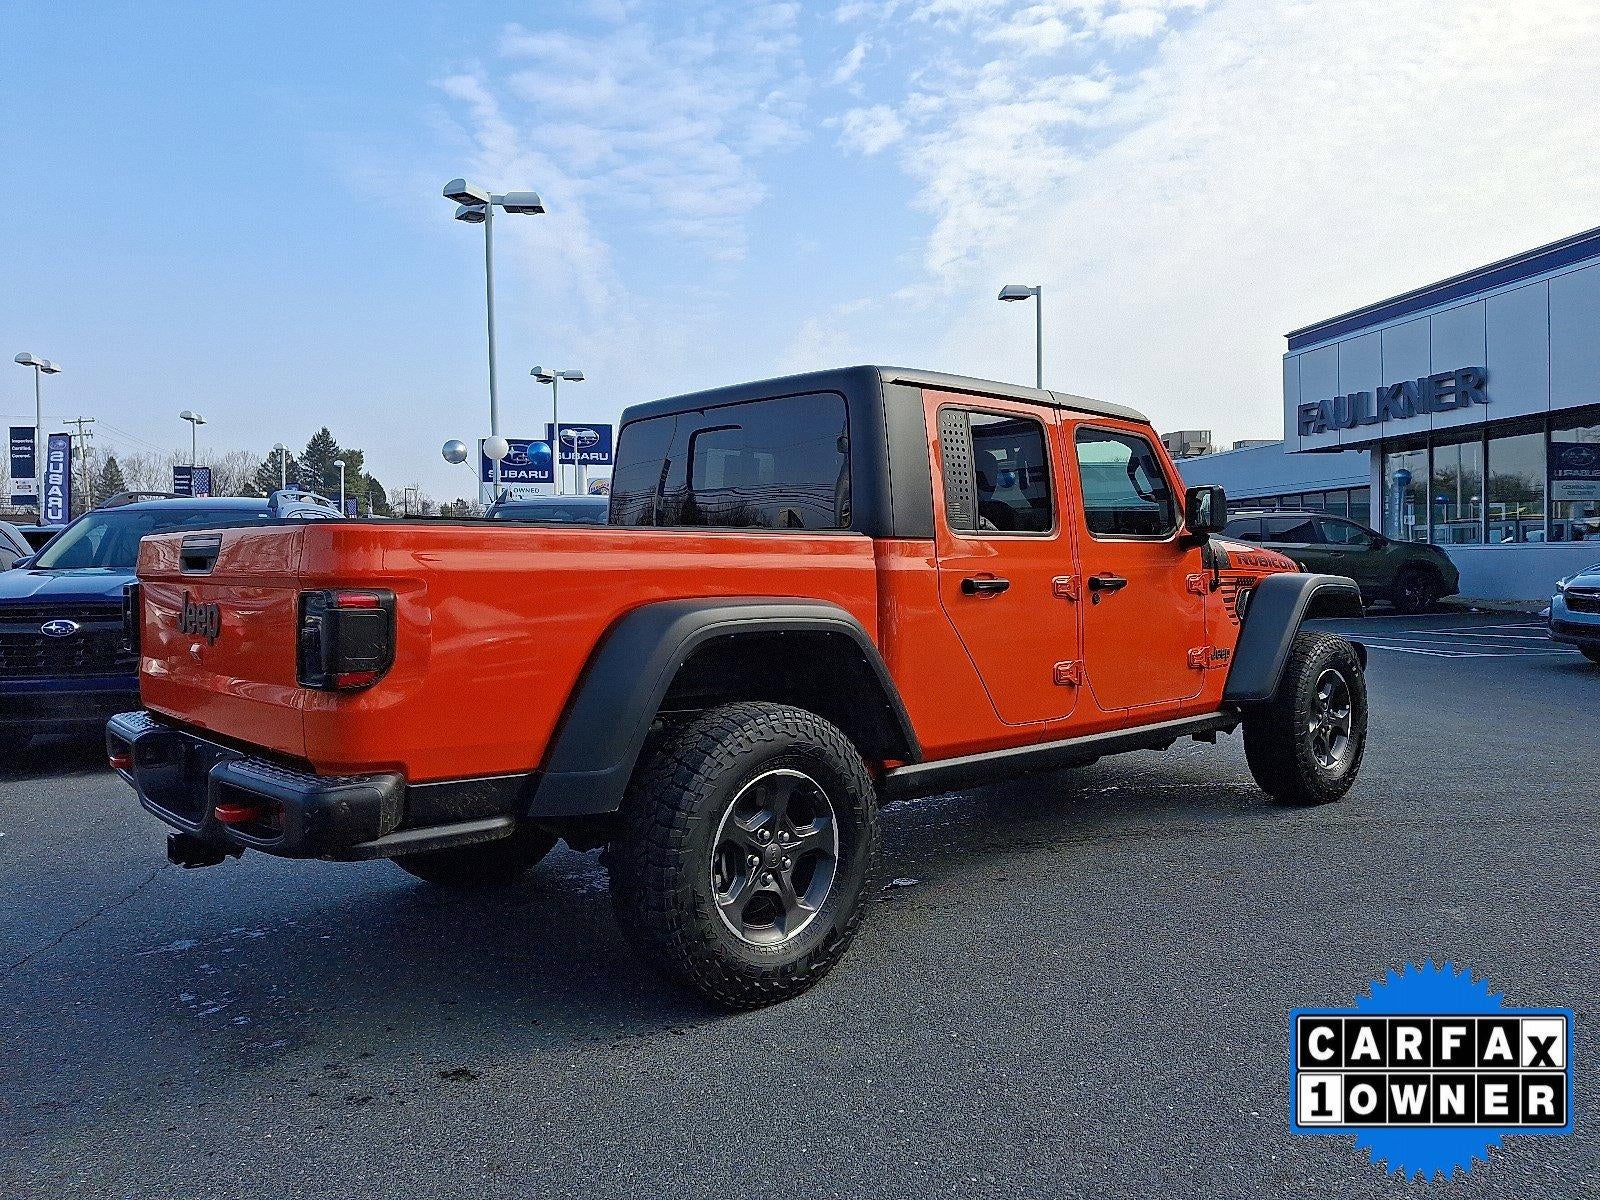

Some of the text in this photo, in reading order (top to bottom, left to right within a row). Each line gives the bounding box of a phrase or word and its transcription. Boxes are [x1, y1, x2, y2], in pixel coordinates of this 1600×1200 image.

[1298, 366, 1489, 436] FAULKNER
[47, 450, 64, 520] SUBARU
[1236, 553, 1297, 571] RUBICON
[176, 590, 220, 646] Jeep
